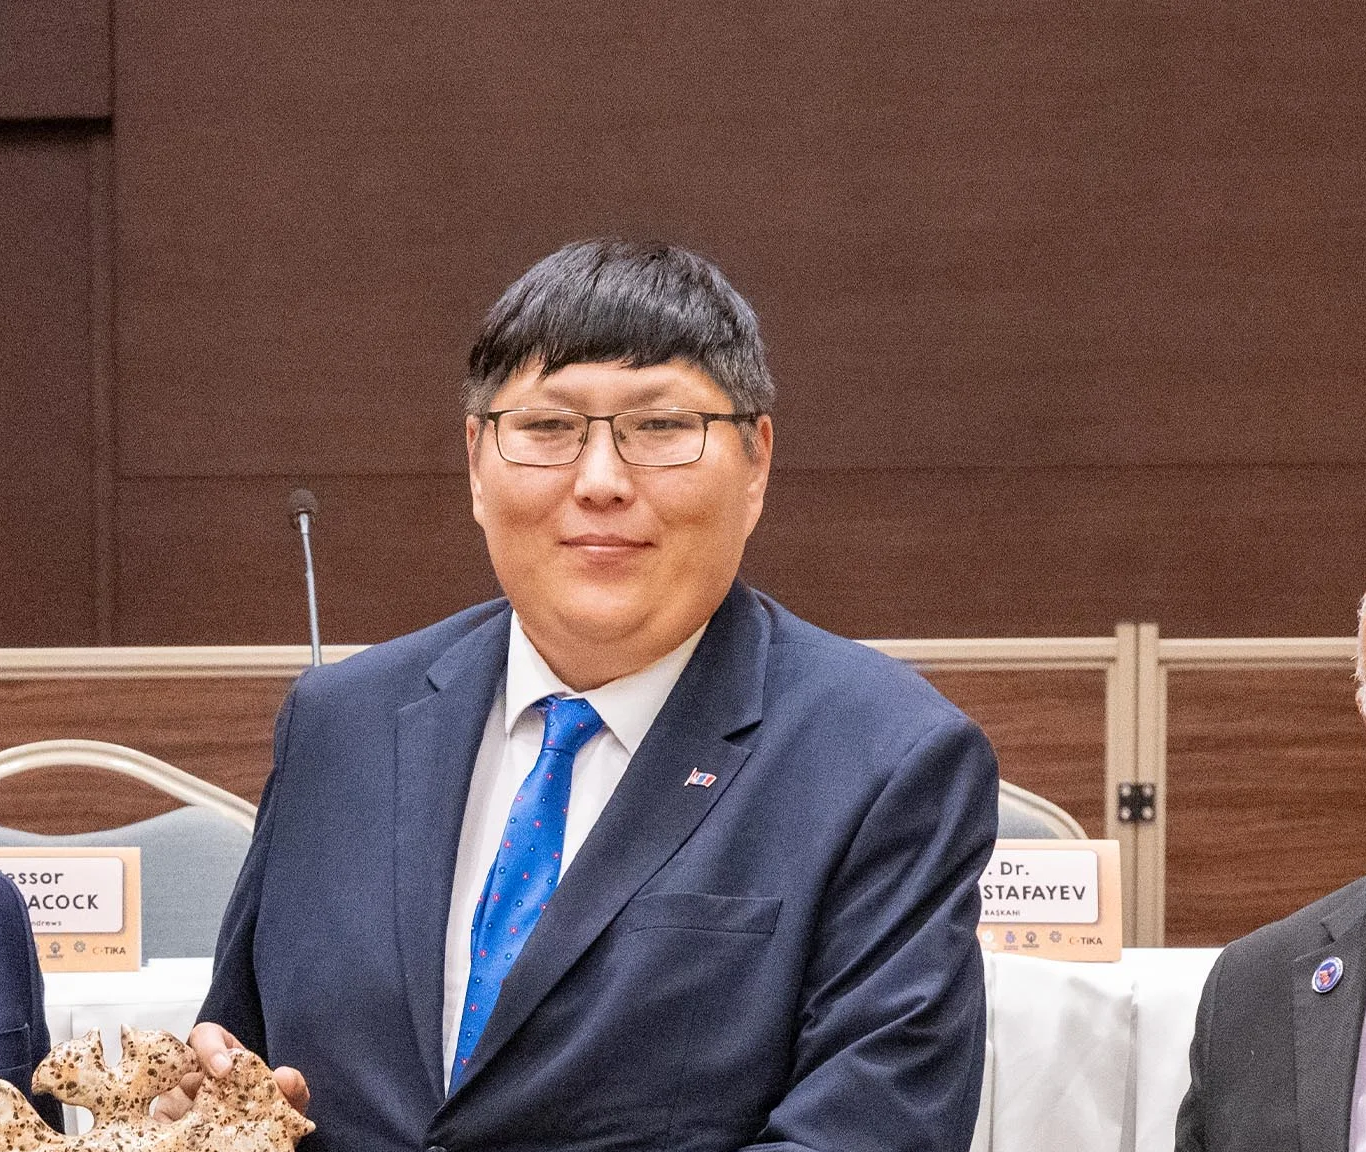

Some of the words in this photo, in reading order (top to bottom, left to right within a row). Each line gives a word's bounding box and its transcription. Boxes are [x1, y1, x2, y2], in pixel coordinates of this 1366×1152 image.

[1000, 861, 1030, 876] Dr.
[6, 871, 65, 885] essor
[983, 884, 1086, 901] STAFAYEV
[27, 894, 99, 910] ACOCK
